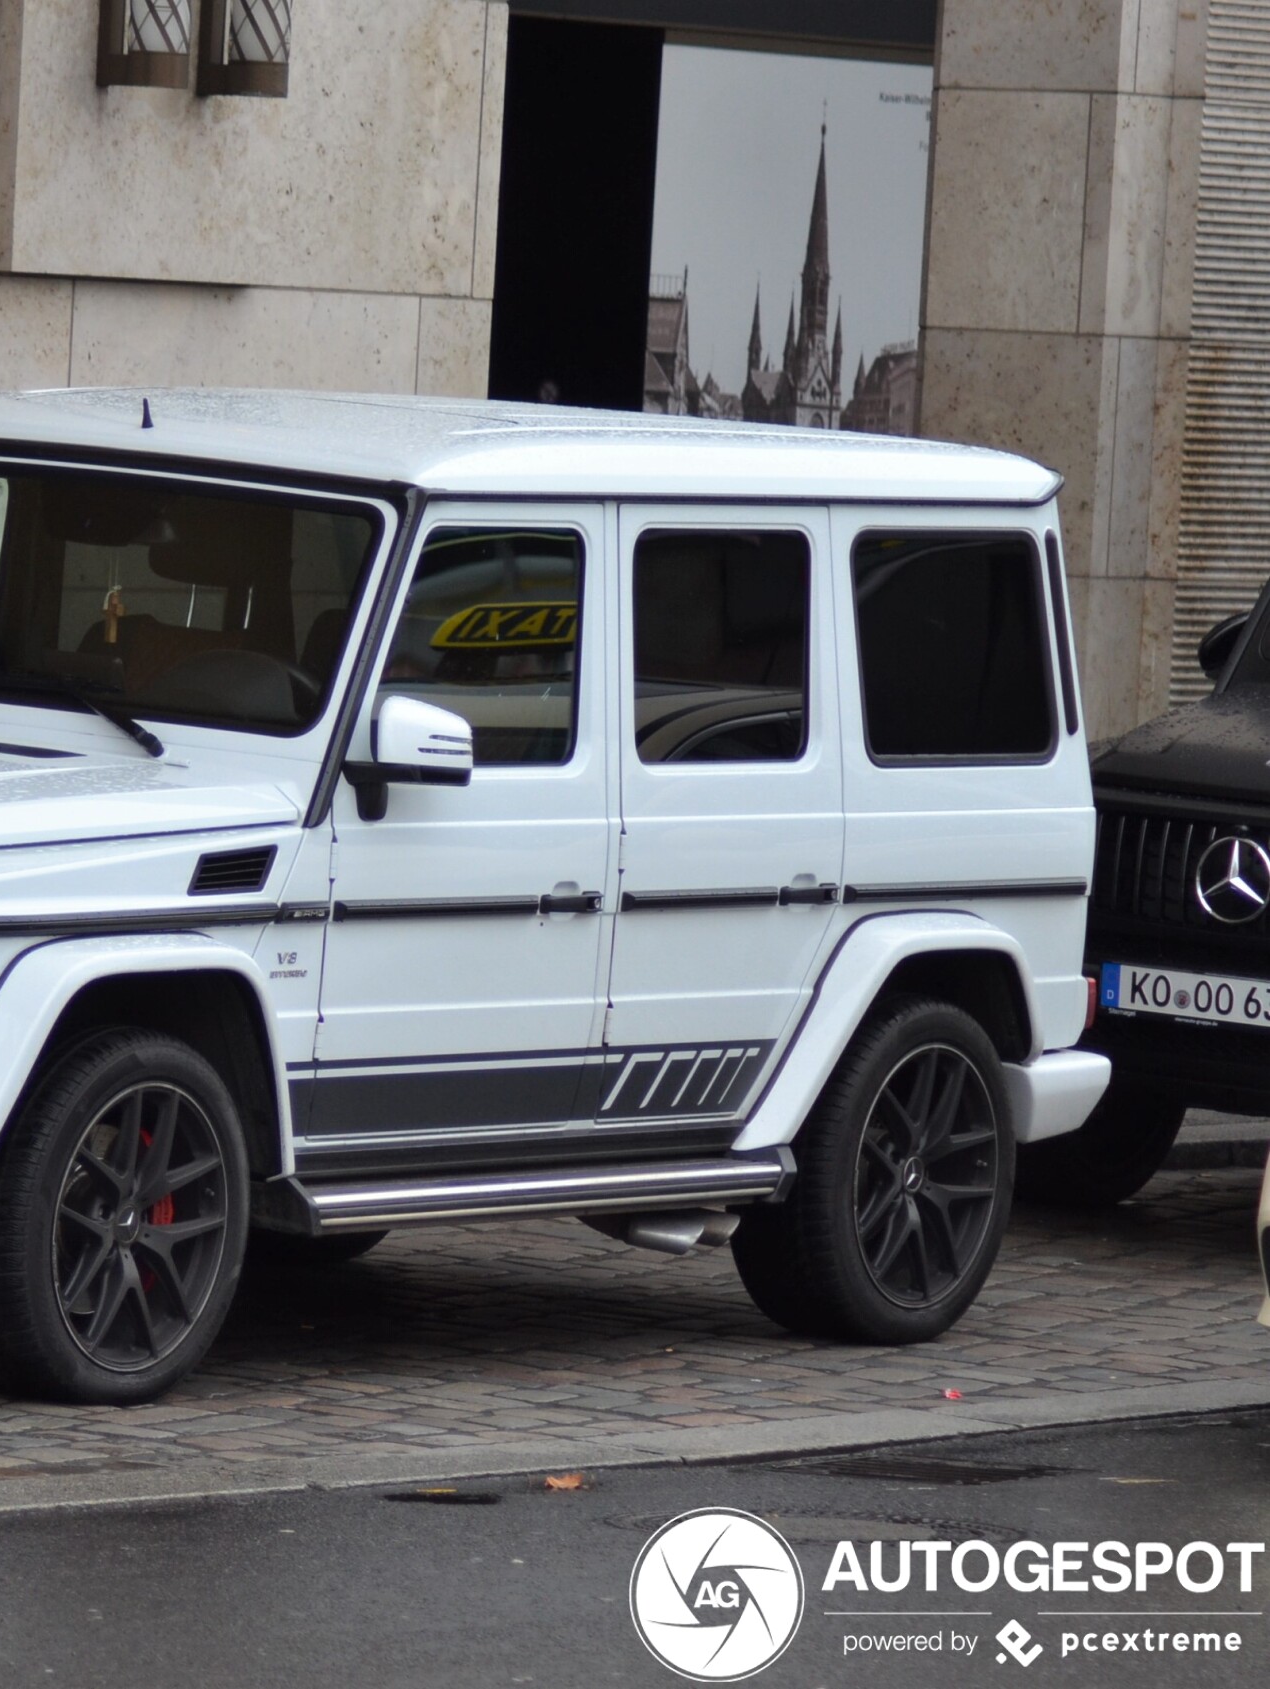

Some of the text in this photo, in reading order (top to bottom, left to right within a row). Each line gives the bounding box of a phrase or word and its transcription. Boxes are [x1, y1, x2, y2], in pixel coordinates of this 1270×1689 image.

[277, 952, 298, 965] V8
[1106, 989, 1115, 1000] D
[1130, 971, 1171, 1007] KO
